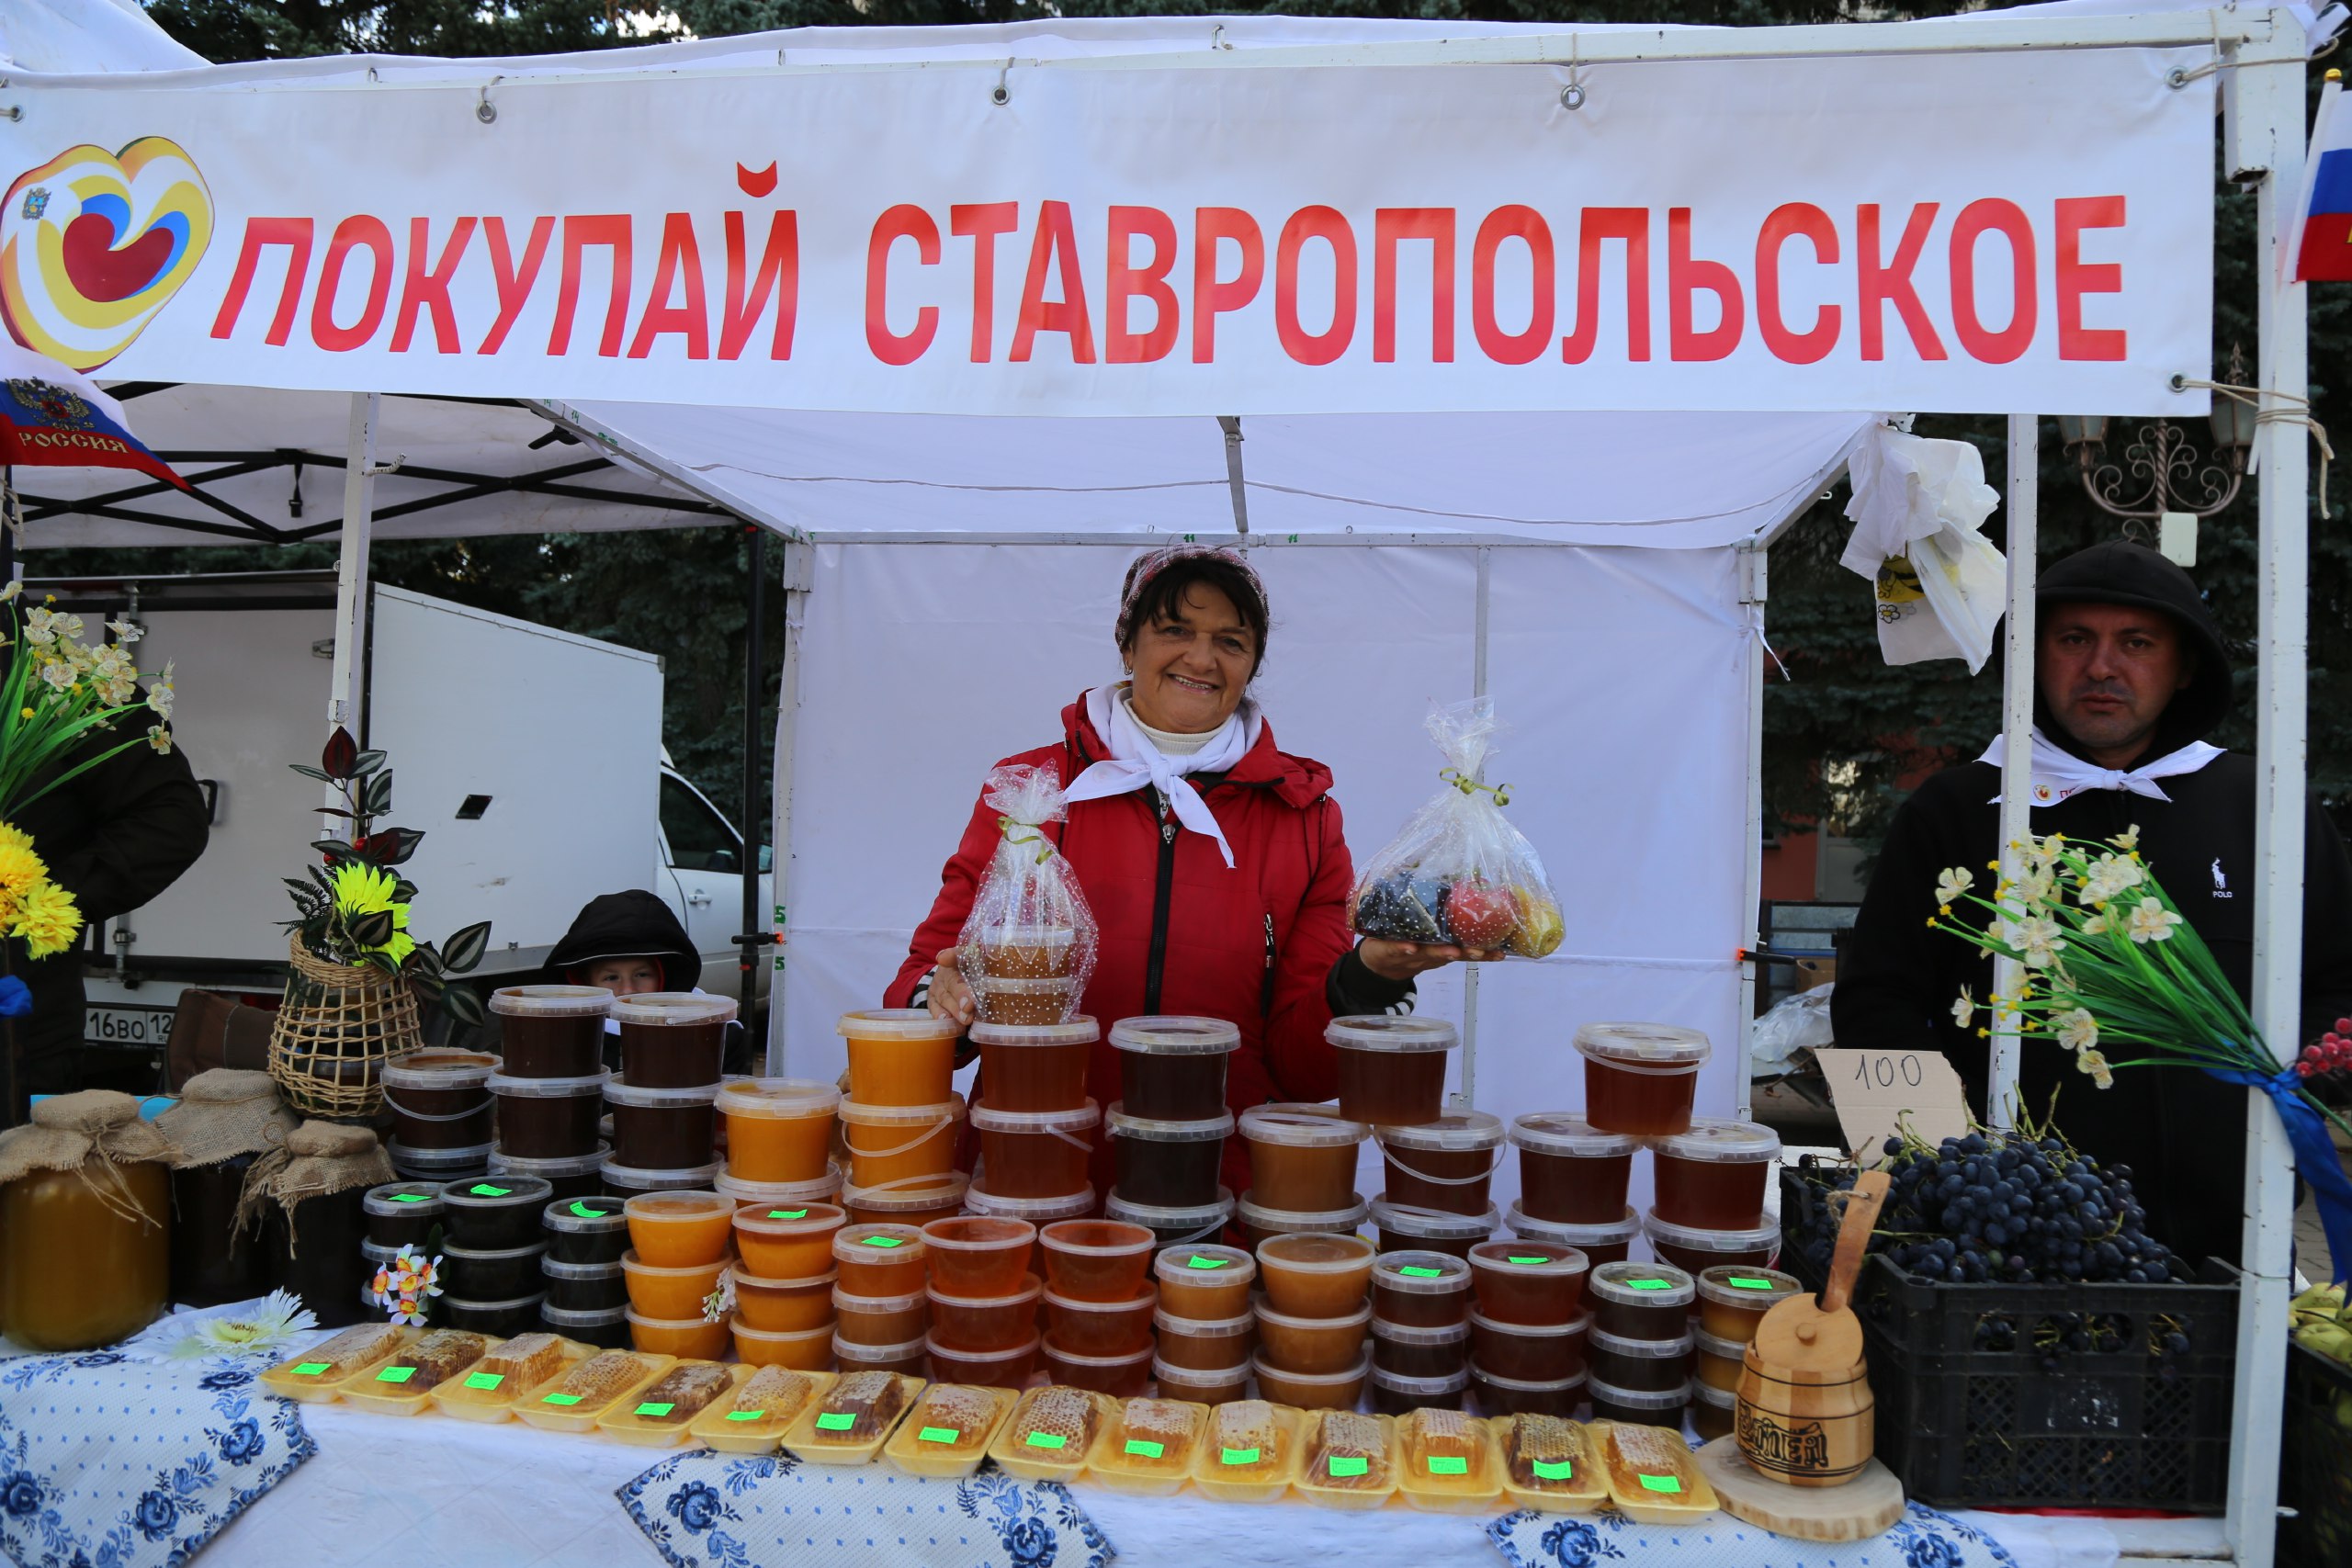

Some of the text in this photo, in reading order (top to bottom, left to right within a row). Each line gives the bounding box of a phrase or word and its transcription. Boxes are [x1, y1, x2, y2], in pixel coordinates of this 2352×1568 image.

[210, 160, 2127, 366] ПОКУПАЙ СТАВРОПОЛЬСКОЕ
[18, 433, 129, 454] РОССИЯ
[1855, 1054, 1922, 1090] 100
